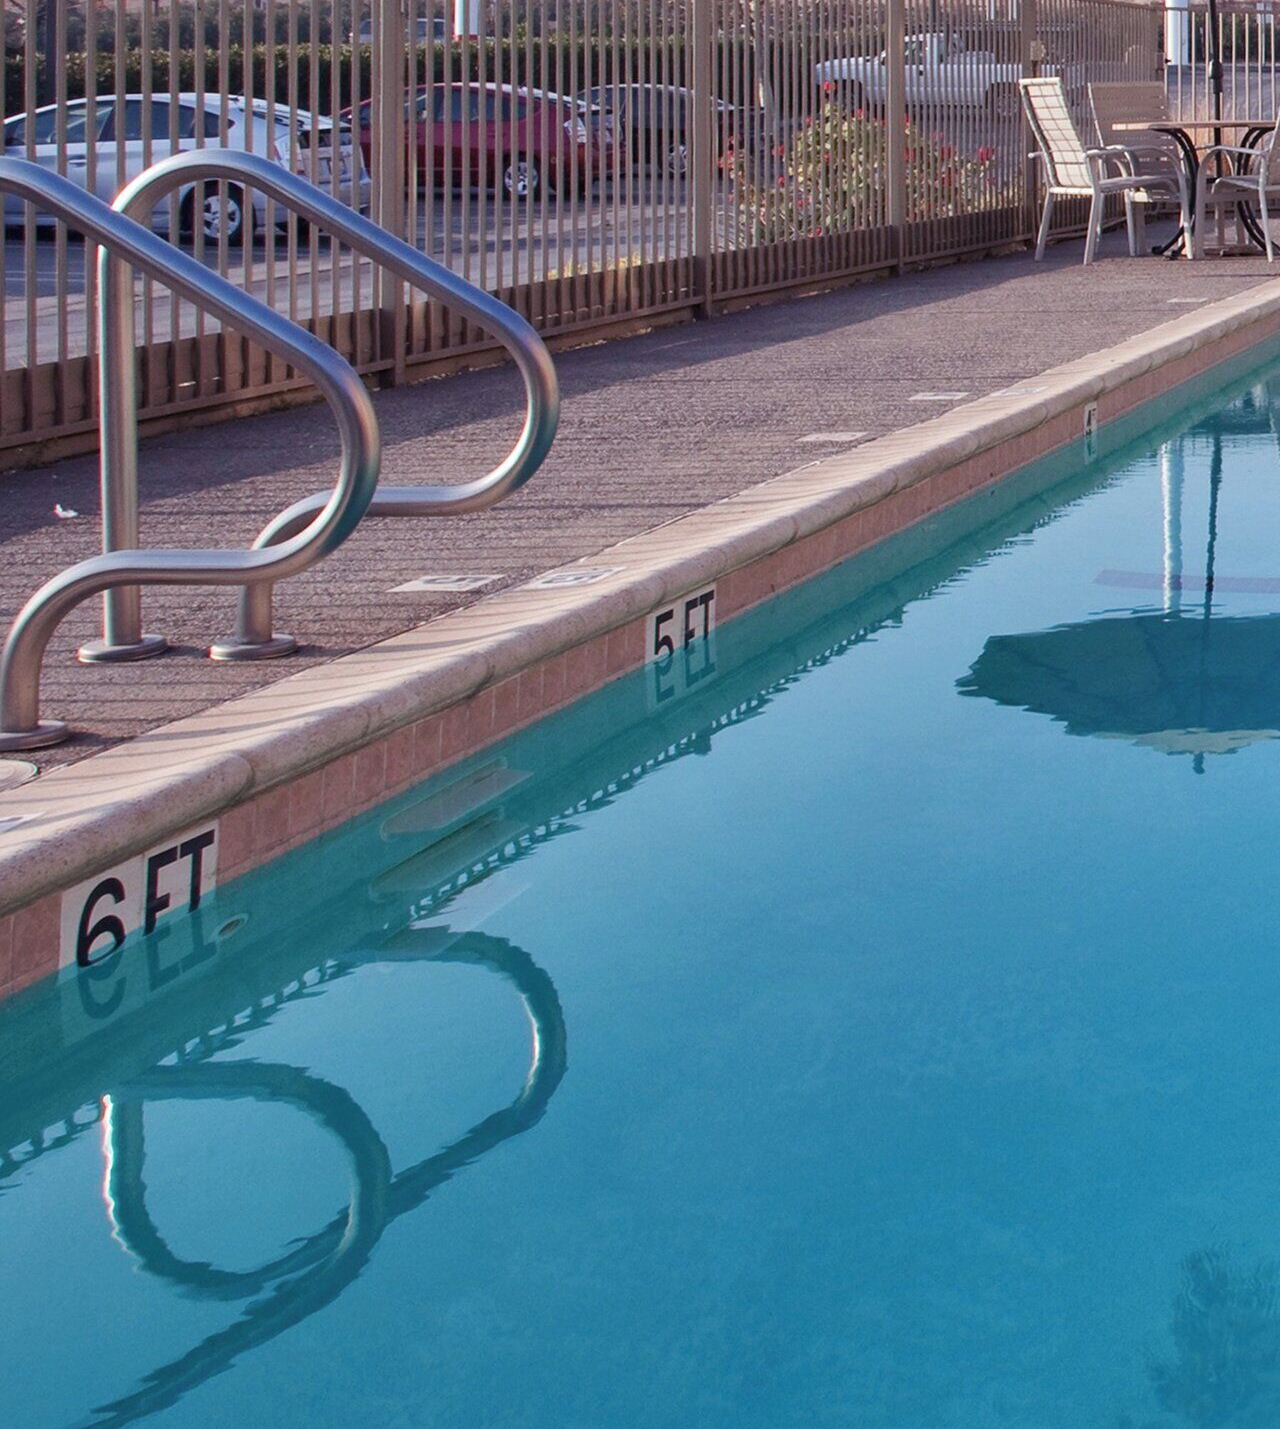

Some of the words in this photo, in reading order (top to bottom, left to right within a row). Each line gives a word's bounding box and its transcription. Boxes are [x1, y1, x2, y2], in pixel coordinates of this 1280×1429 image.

[654, 609, 674, 657] 5
[684, 589, 715, 651] FT
[77, 877, 126, 968] 6
[143, 828, 215, 937] FT
